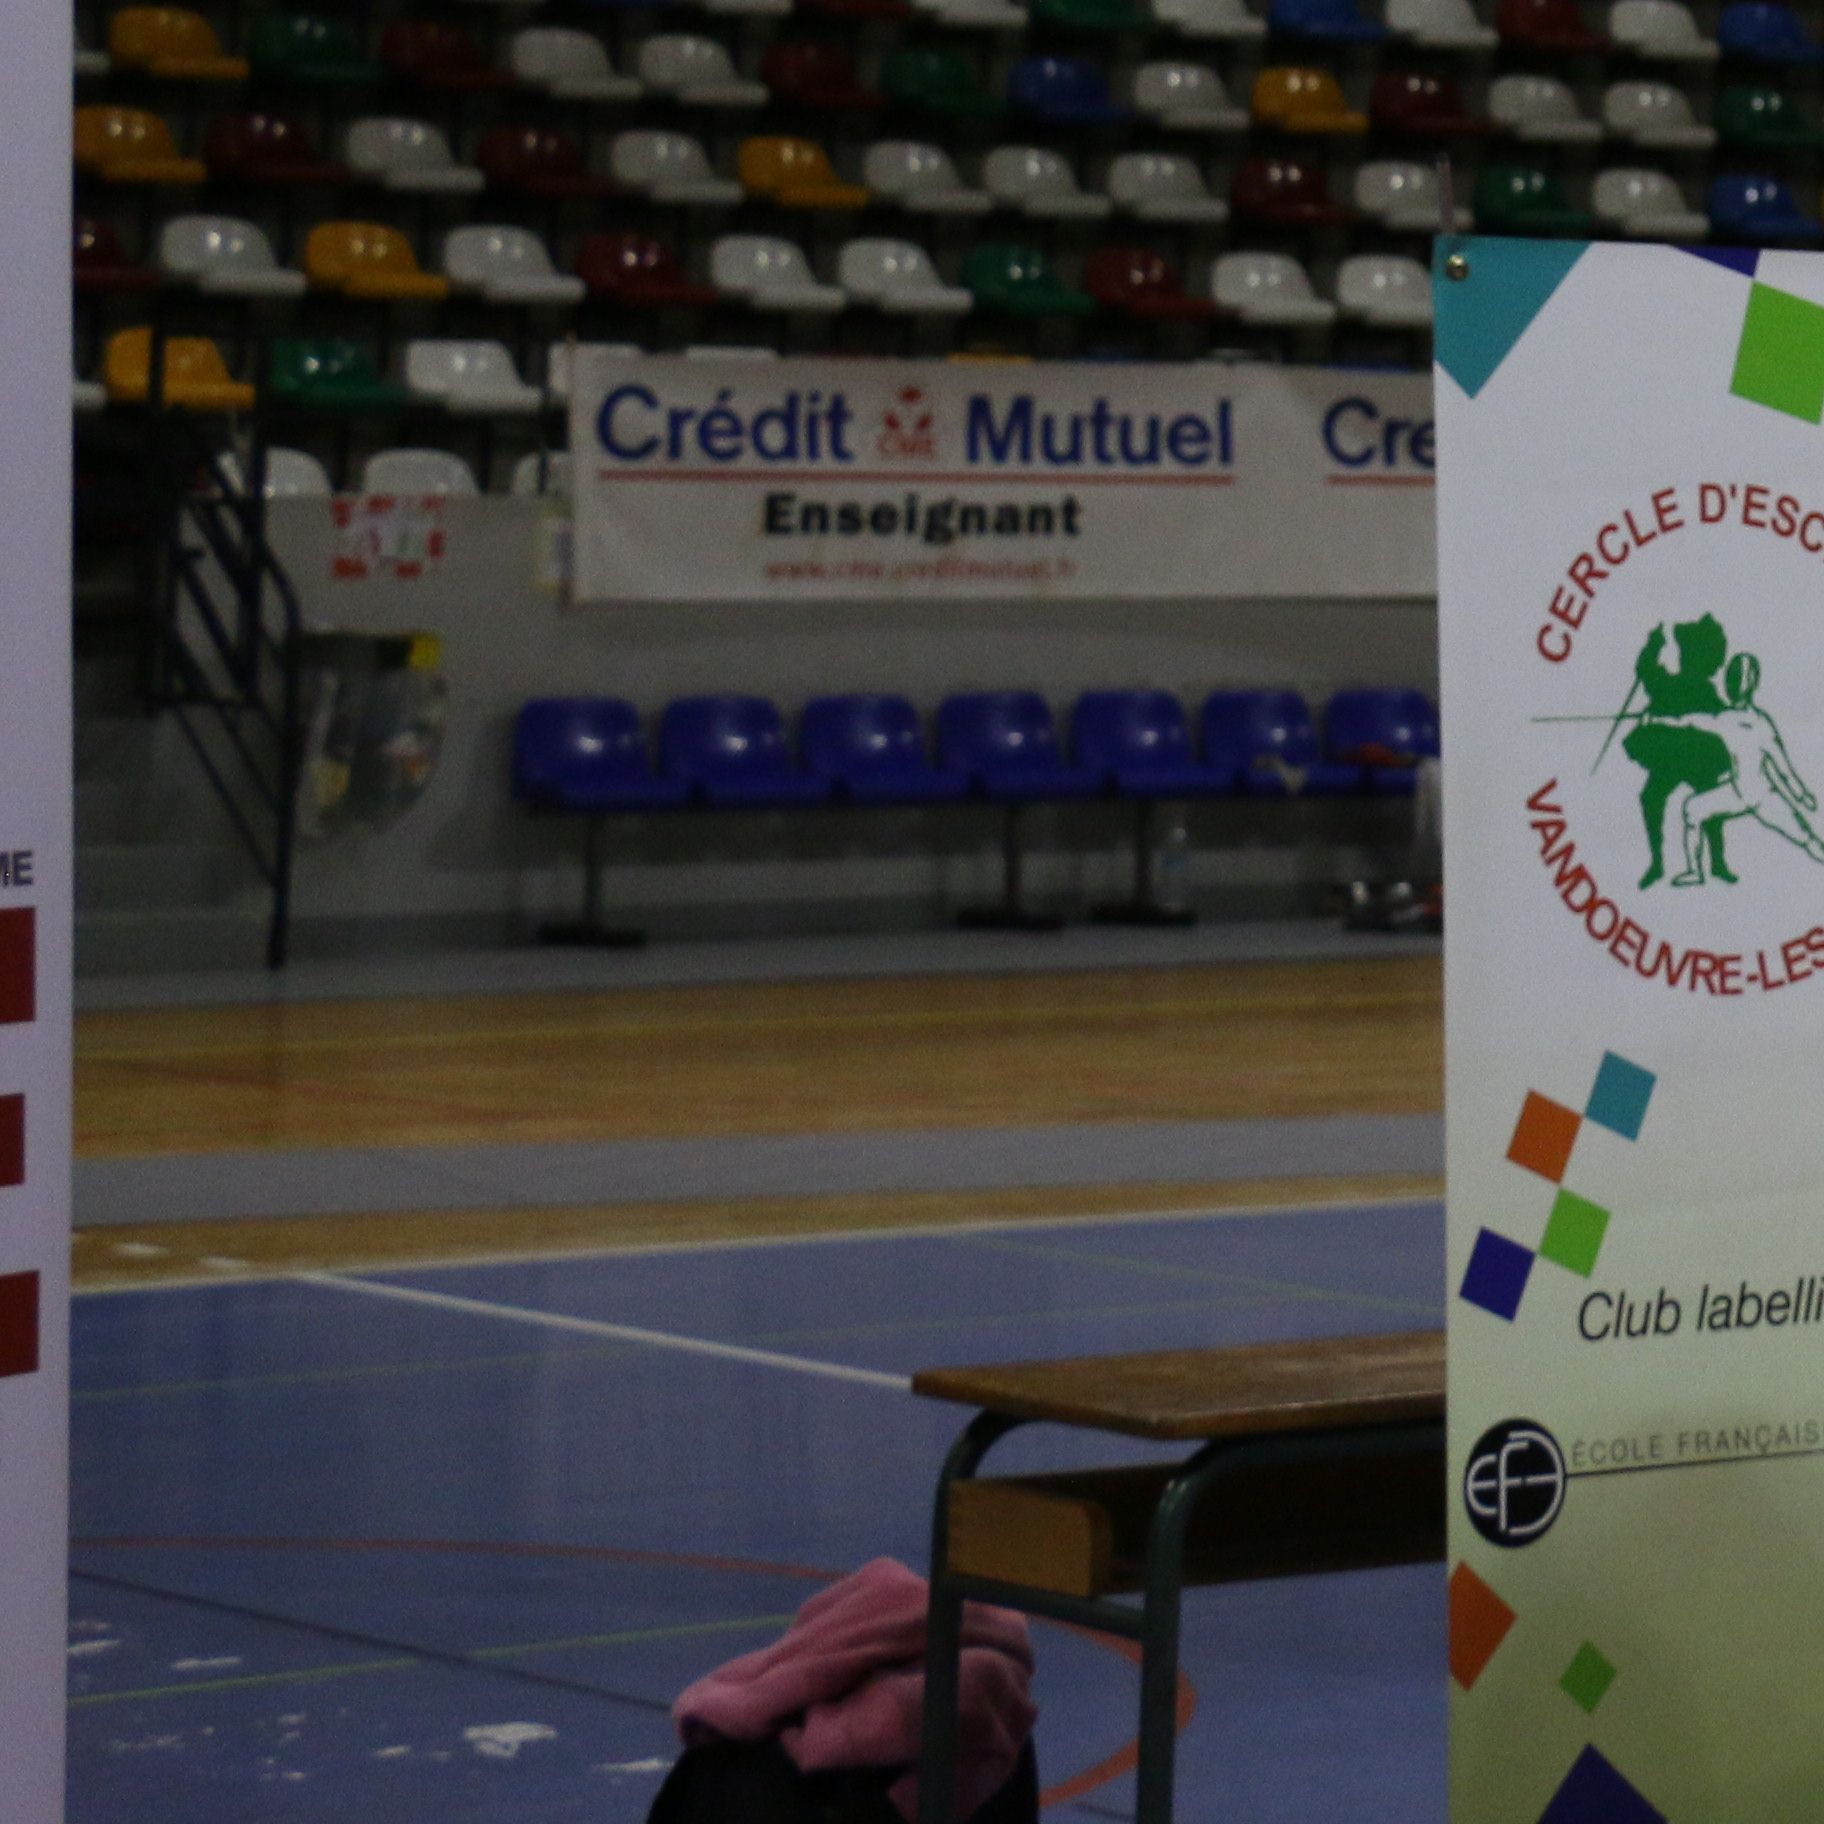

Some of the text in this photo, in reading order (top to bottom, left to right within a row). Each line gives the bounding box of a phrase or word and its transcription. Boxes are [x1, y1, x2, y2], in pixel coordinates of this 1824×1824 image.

[598, 384, 1233, 467] Crédit Mutuel
[762, 492, 1082, 545] Enseignant
[1536, 487, 1686, 664] CERCLE
[1578, 1286, 1682, 1341] Club
[1571, 1436, 1663, 1467] ÉCOLE
